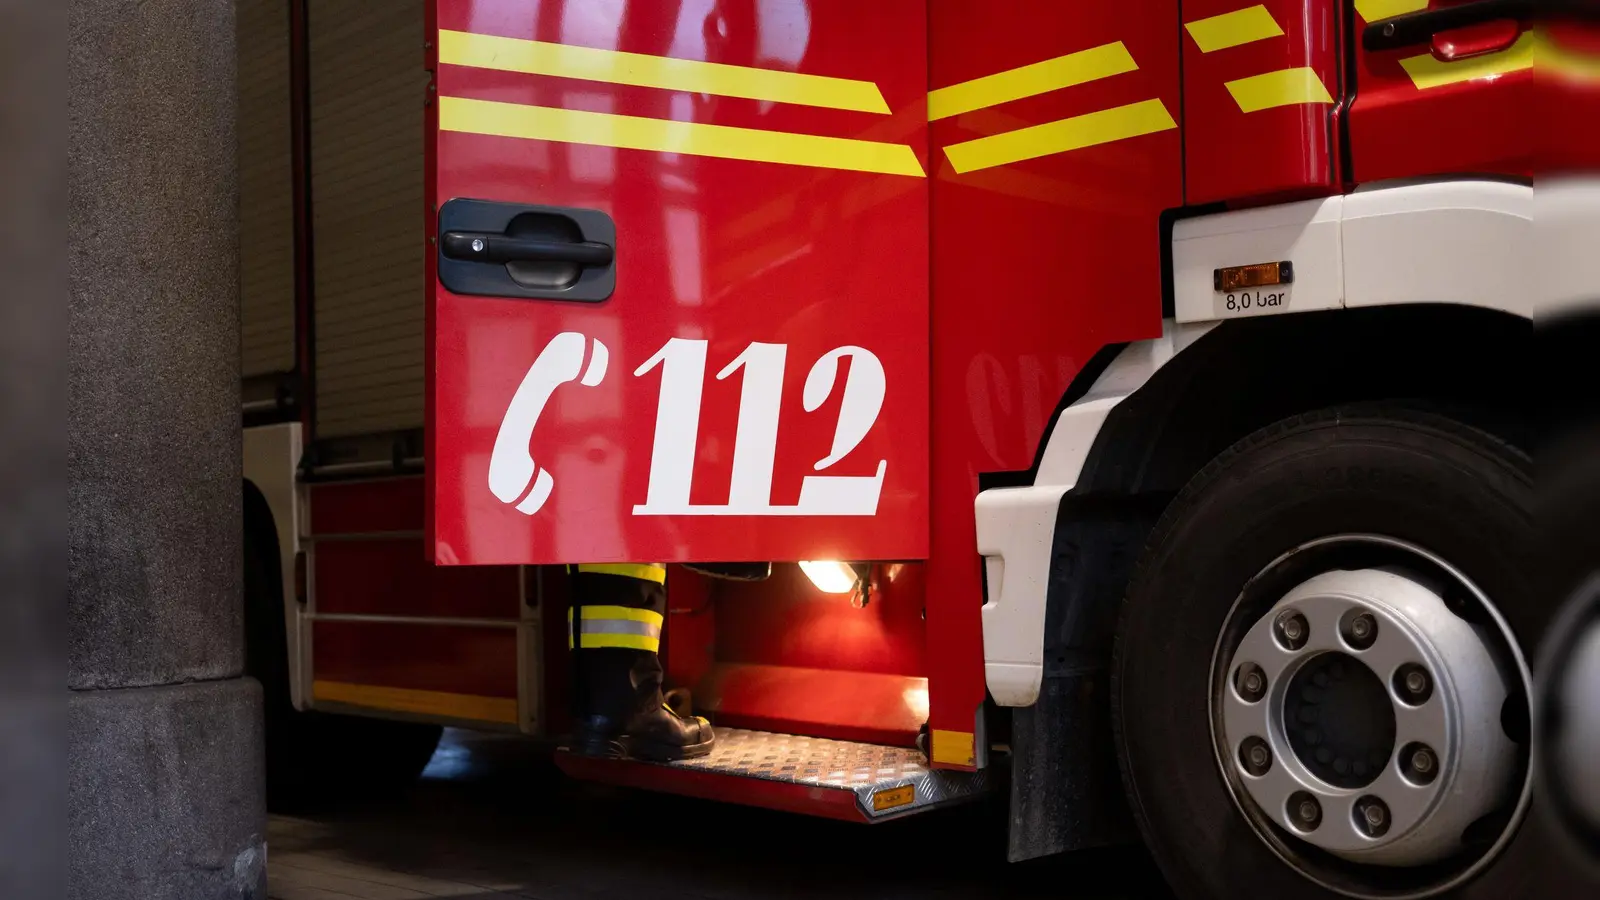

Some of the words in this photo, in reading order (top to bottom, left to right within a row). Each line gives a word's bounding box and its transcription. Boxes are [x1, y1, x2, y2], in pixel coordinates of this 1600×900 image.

[1226, 292, 1251, 312] 8,0
[1256, 291, 1285, 307] bar
[631, 337, 888, 516] 112
